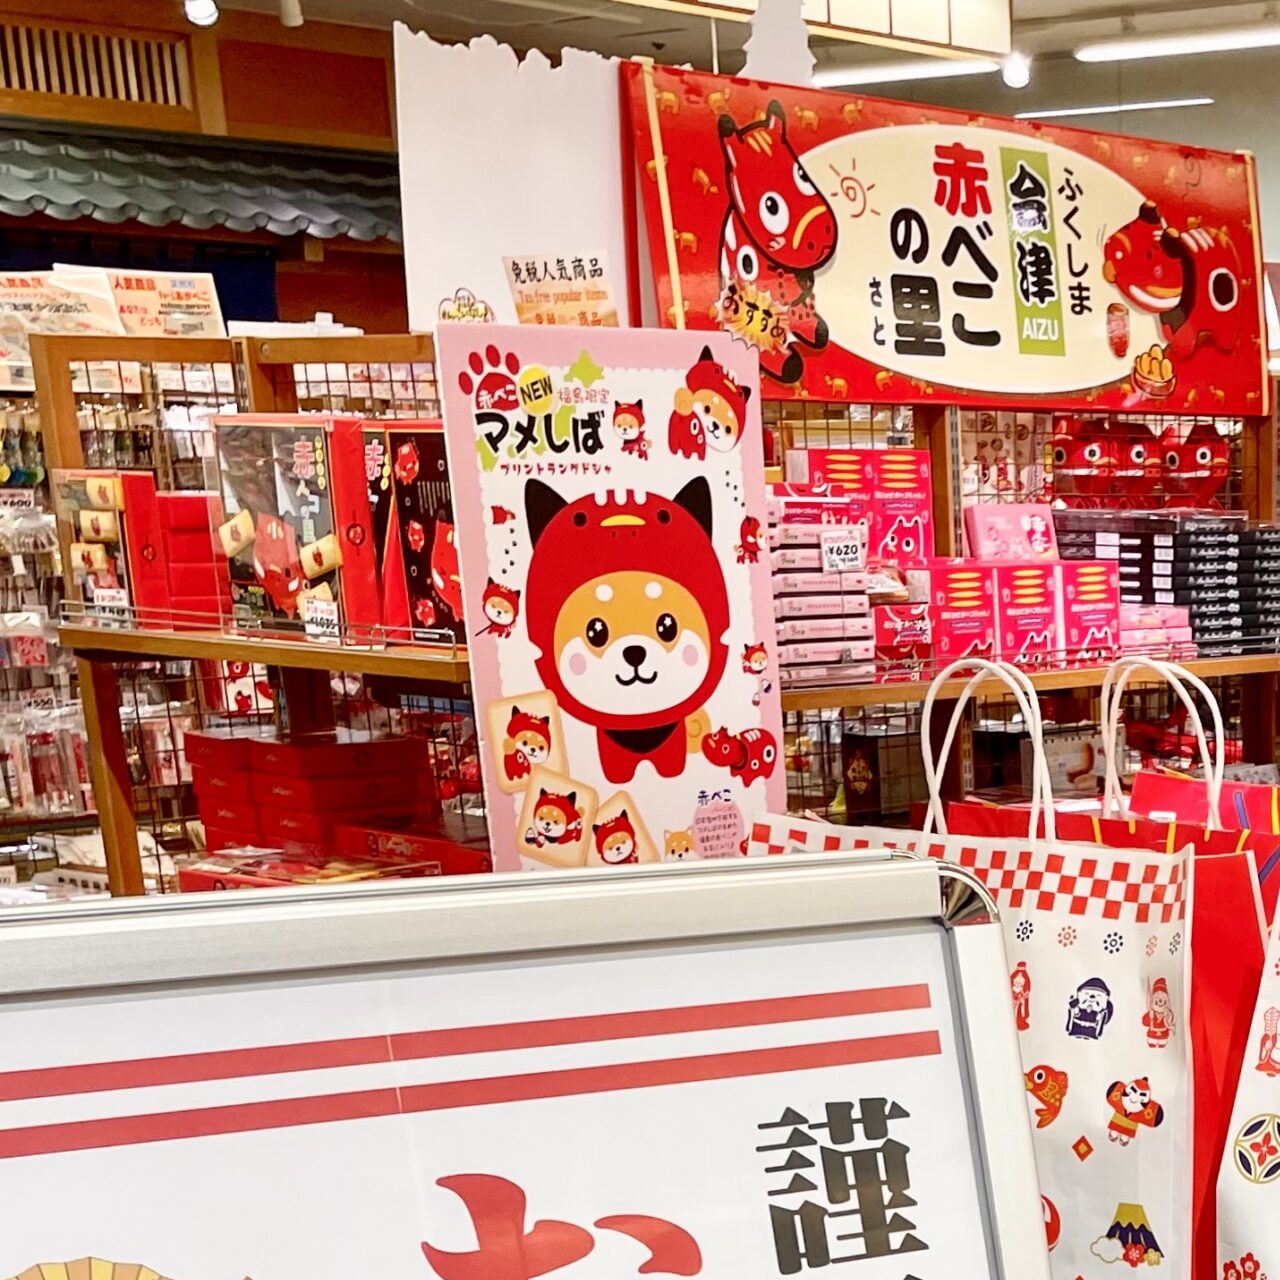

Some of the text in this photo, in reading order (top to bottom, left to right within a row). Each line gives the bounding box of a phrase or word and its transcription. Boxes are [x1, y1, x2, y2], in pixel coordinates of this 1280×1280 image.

[933, 142, 1001, 347] 赤べこ
[1010, 163, 1056, 304] 会津
[1058, 167, 1092, 315] ふくしま
[511, 257, 603, 284] 免税人気商品
[890, 207, 946, 357] の里
[723, 284, 787, 344] おすすめ
[869, 276, 886, 345] さと
[1022, 317, 1059, 340] AIZU
[519, 375, 554, 406] NEW
[475, 409, 606, 455] マメしば
